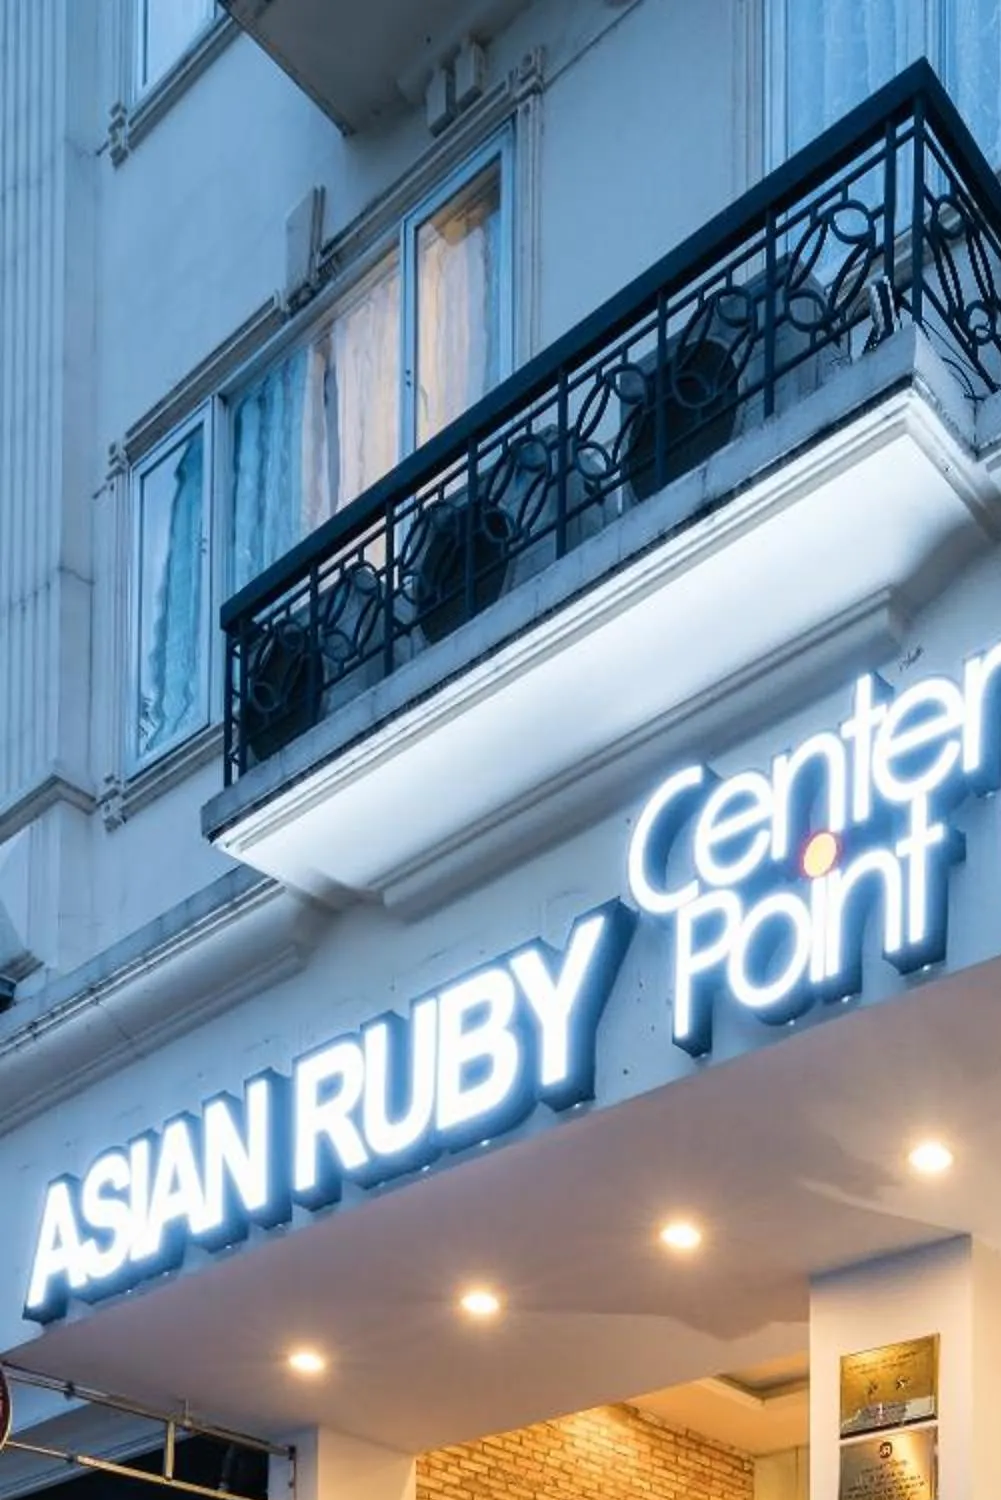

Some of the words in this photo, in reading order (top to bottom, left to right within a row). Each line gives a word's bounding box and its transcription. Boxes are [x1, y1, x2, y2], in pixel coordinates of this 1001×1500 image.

[671, 796, 952, 1043] Point
[24, 1076, 274, 1312] ASIAN
[292, 912, 612, 1197] RUBY
